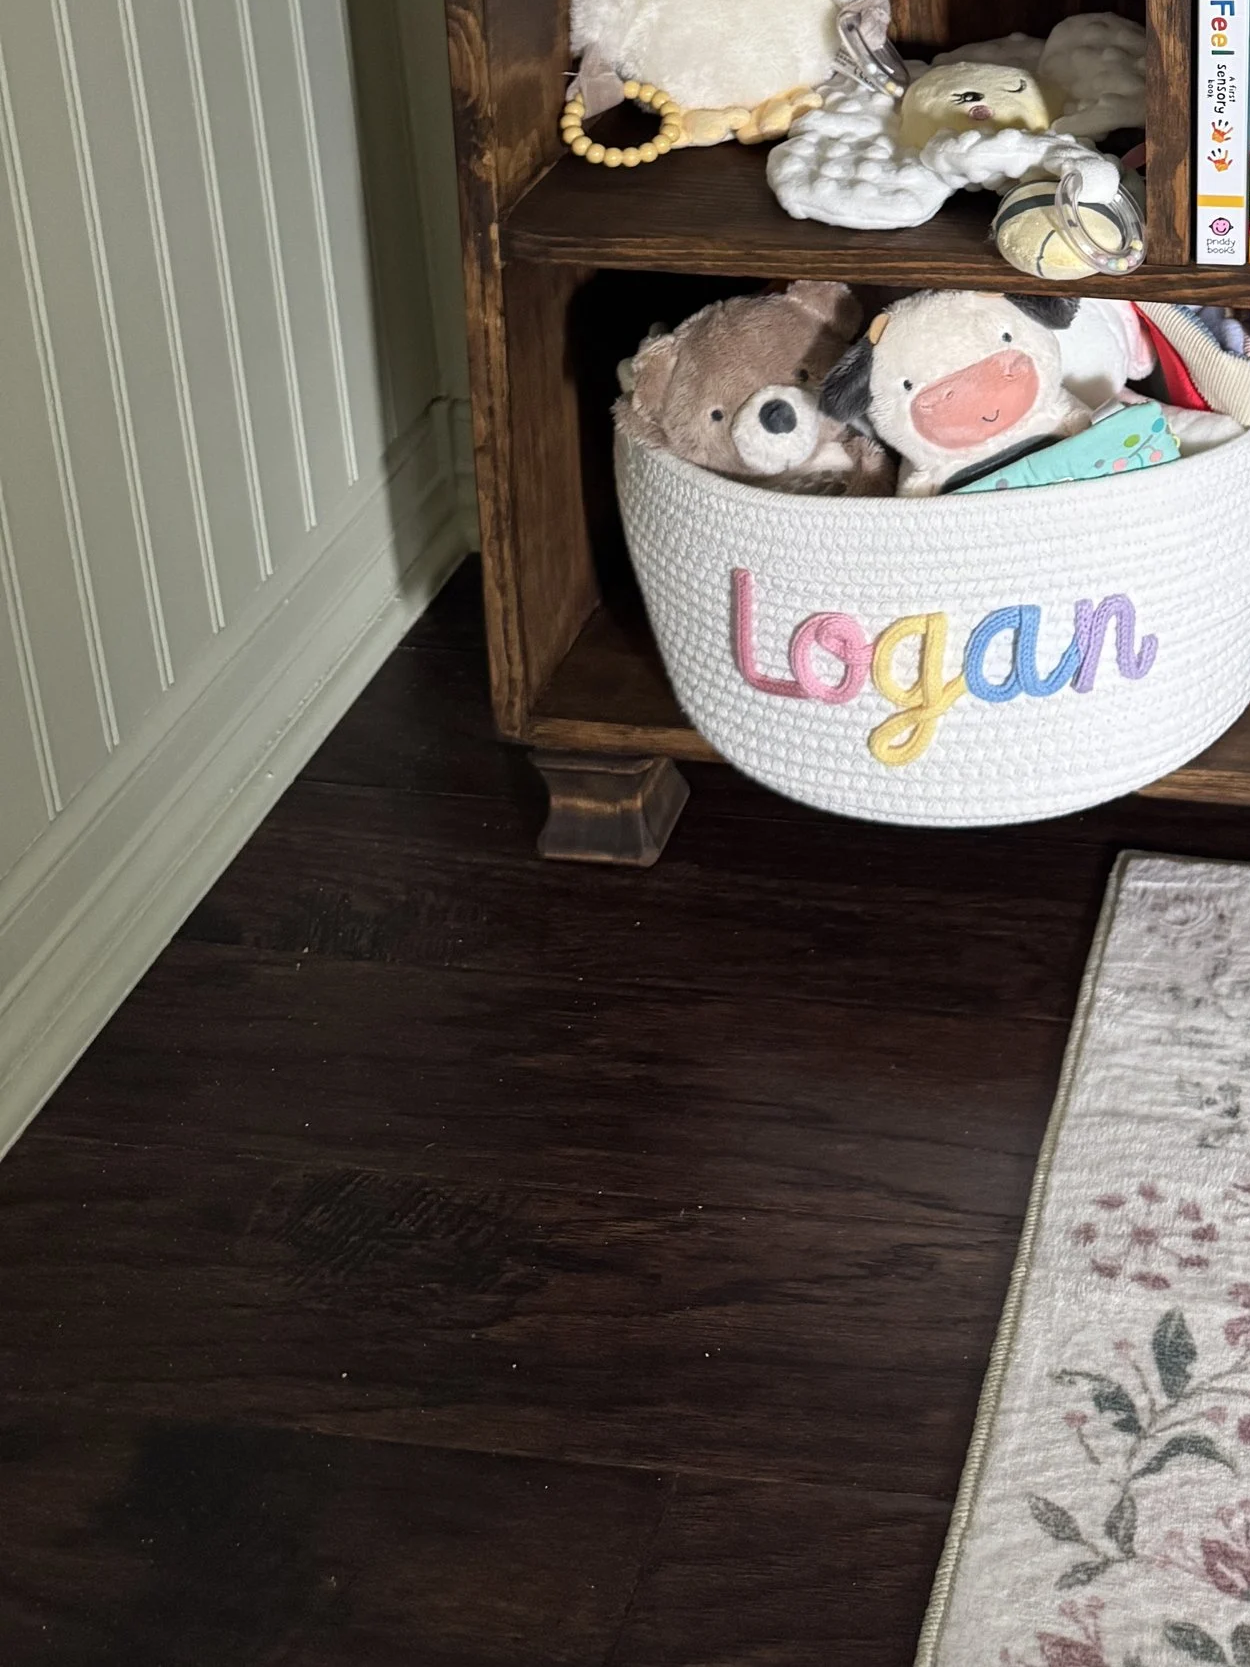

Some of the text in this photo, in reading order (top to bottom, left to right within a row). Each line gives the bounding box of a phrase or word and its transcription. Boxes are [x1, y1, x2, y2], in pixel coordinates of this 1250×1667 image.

[1210, 0, 1235, 55] Feel
[1214, 64, 1227, 114] sensory
[1206, 238, 1236, 249] priddy
[1207, 246, 1235, 254] books
[731, 568, 1158, 766] Logan
